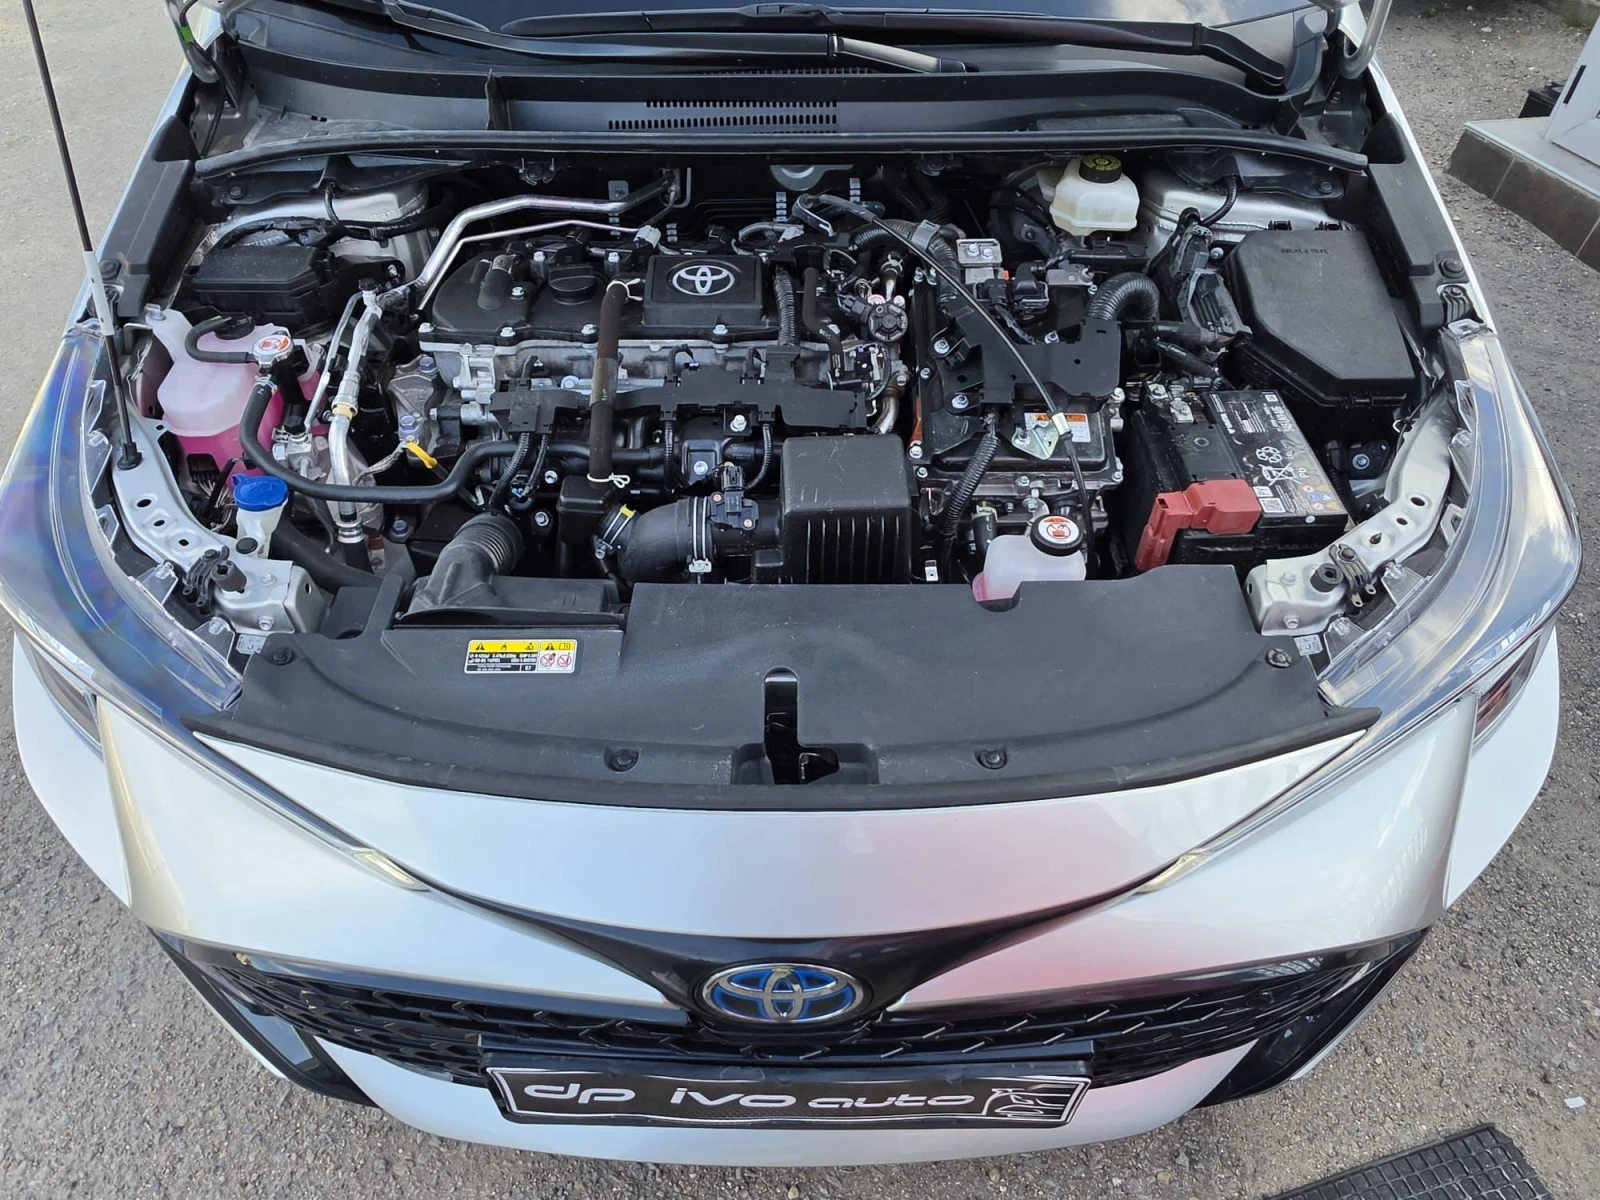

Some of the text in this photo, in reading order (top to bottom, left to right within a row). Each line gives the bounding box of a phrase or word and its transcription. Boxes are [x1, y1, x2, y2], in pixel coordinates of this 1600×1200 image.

[524, 1083, 976, 1108] dp ivo auto
